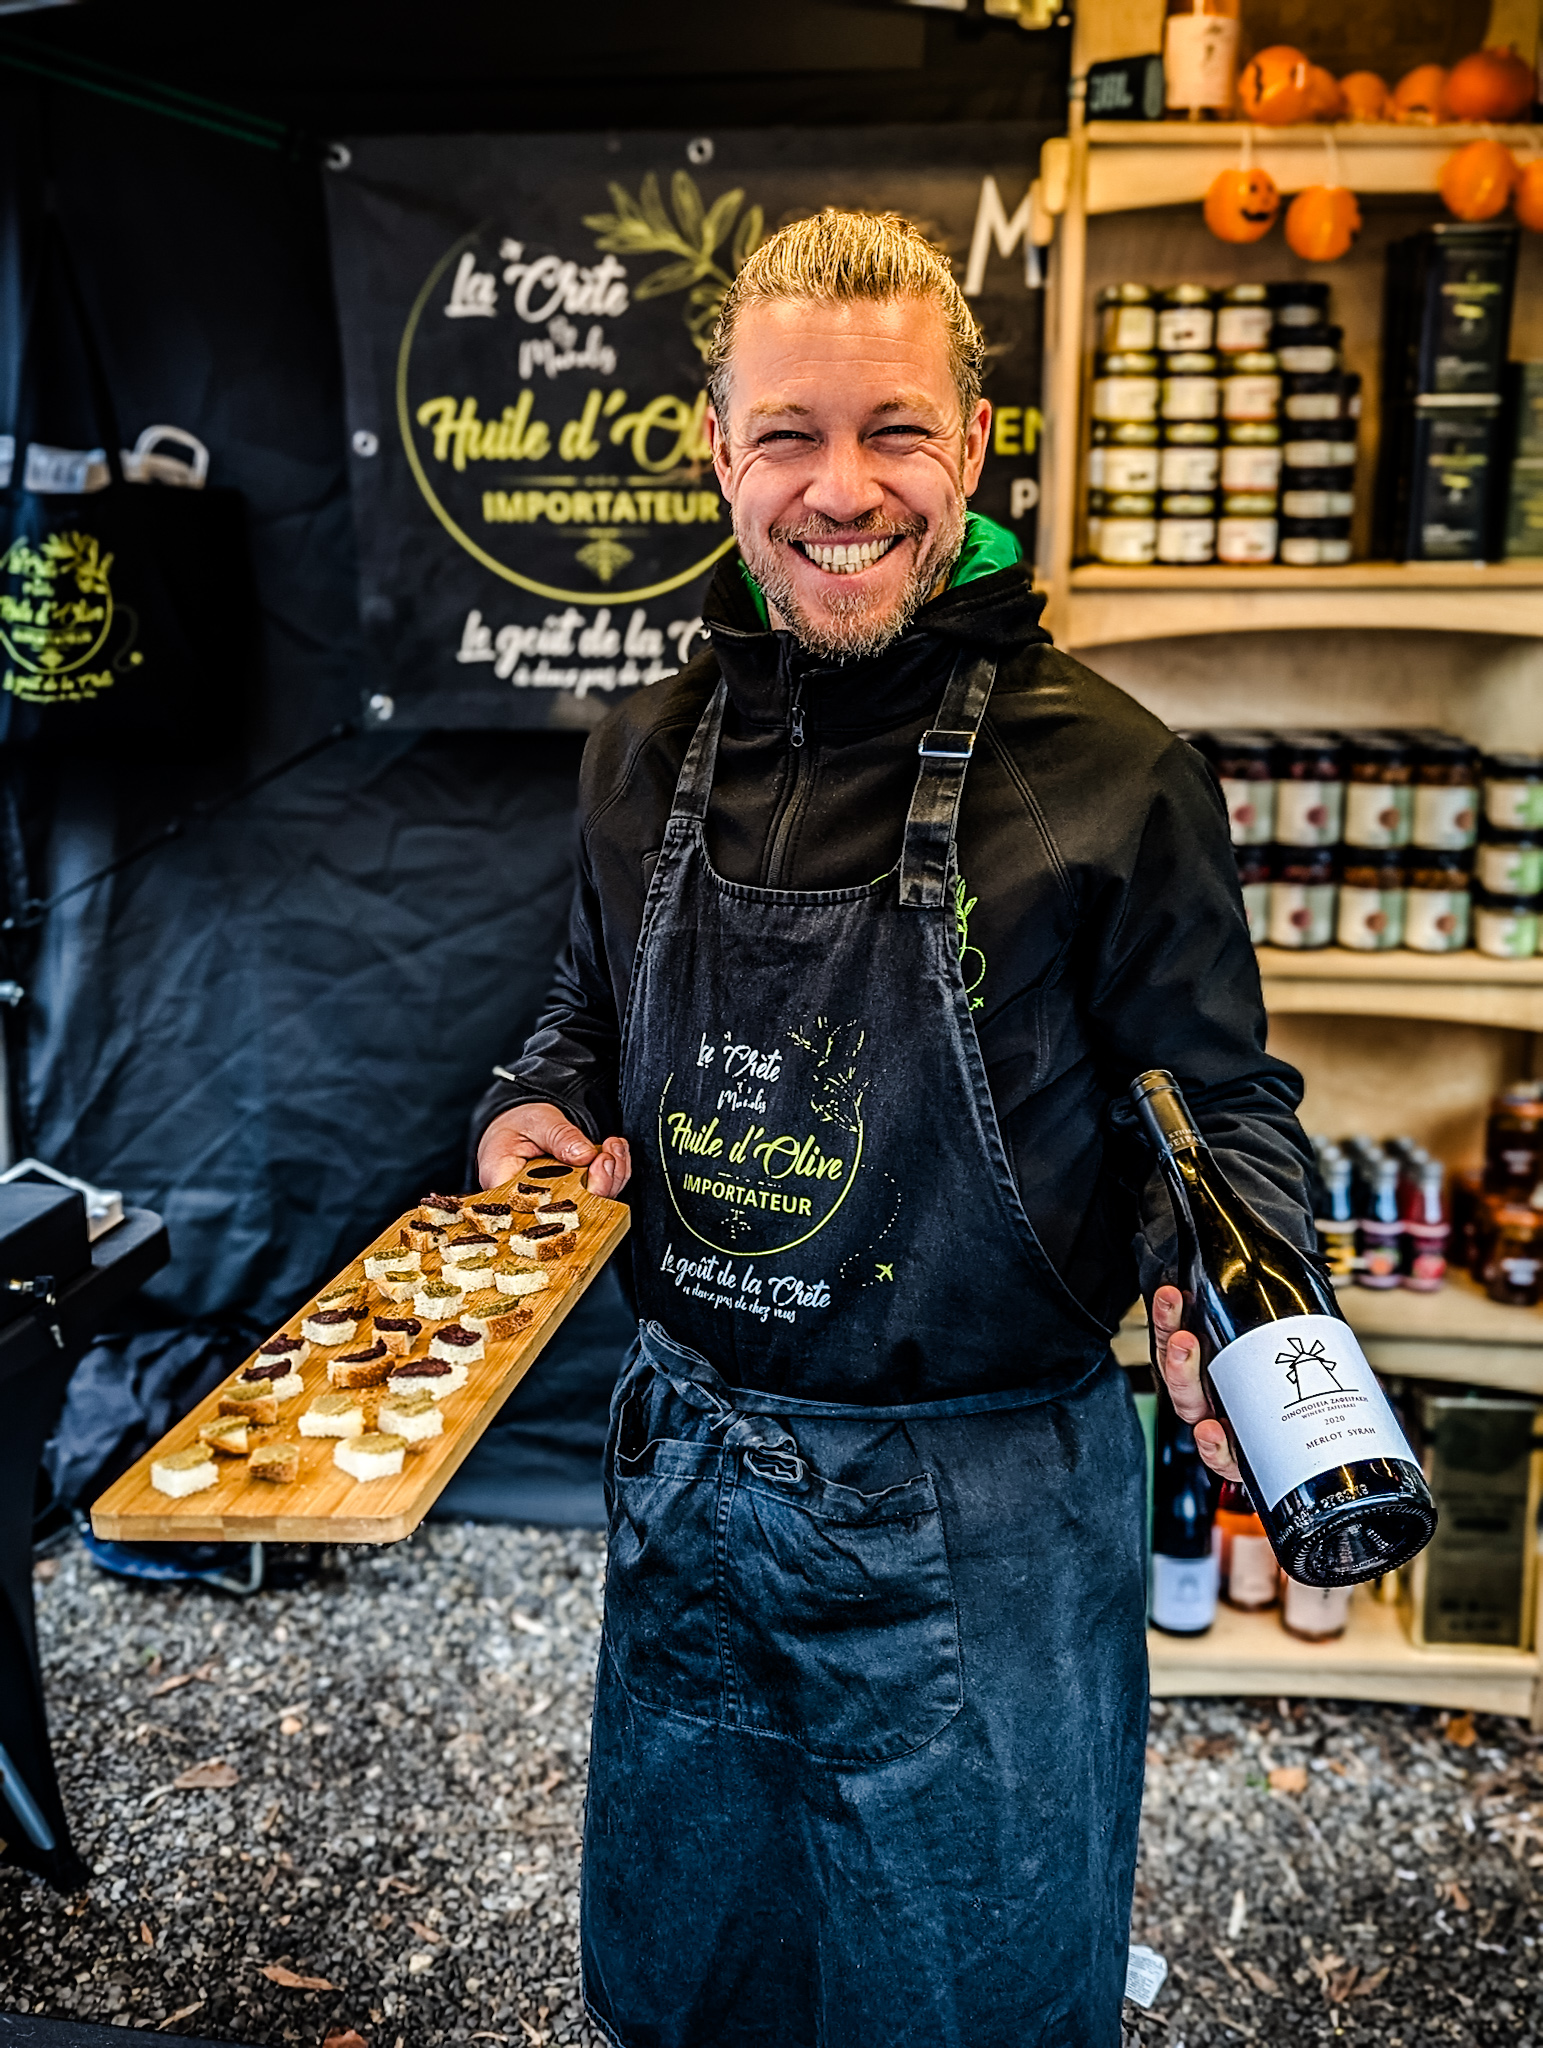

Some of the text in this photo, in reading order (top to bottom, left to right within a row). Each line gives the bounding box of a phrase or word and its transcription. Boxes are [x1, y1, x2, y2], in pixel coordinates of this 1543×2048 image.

[964, 174, 1044, 297] M
[417, 389, 711, 473] Huile d'Ol
[482, 490, 719, 524] IMPORTATEUR
[578, 608, 621, 658] de
[623, 608, 665, 658] la
[667, 1111, 844, 1181] Huile d'Olive
[682, 1173, 813, 1217] IMPORTATEUR
[660, 1242, 832, 1309] Le goût de la Crète
[734, 1295, 748, 1311] de
[749, 1298, 771, 1323] chez
[1305, 1427, 1377, 1450] MERLOT SYRAH
[1324, 1415, 1346, 1426] 2020
